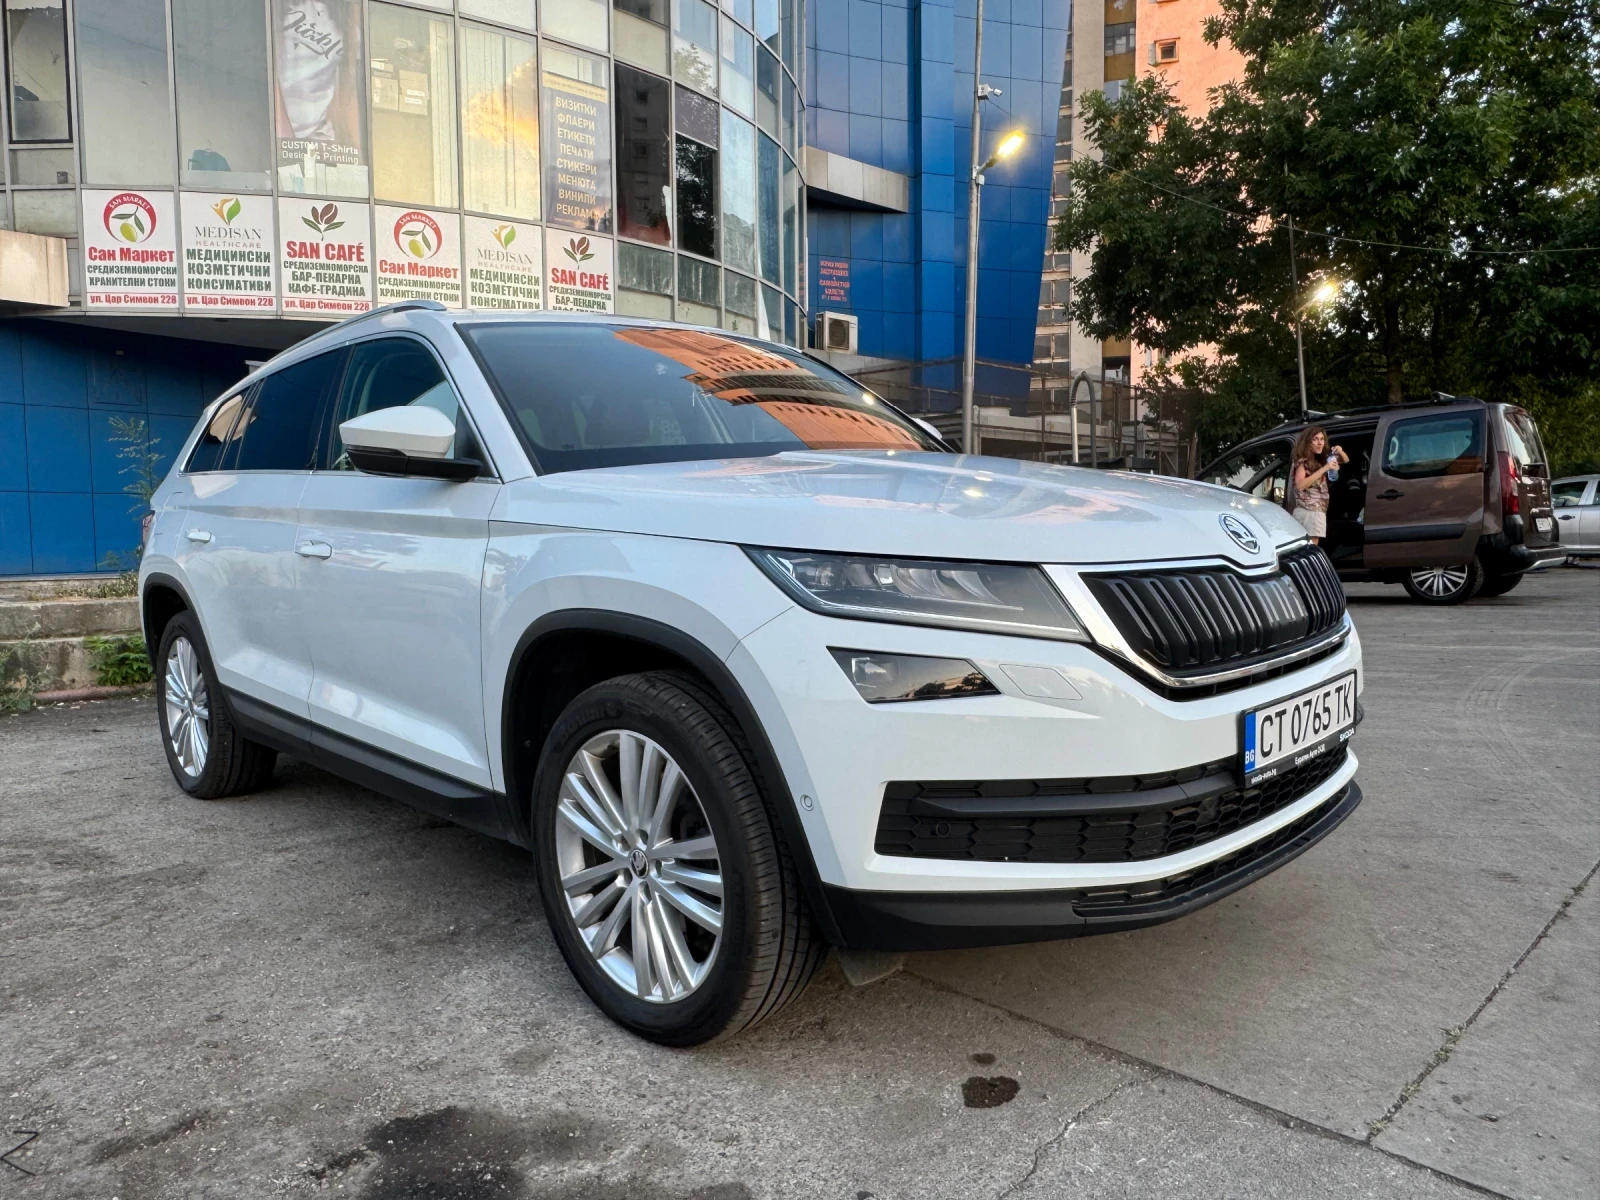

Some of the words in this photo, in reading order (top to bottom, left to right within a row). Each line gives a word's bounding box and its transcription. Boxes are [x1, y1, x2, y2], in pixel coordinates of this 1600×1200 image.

[556, 96, 596, 116] ВИЗИТКИ
[558, 113, 595, 130] ФЛАЕРИ
[558, 128, 596, 146] ЕТИКЕТИ
[321, 143, 358, 154] T-Shirts
[560, 144, 594, 160] ПЕЧАТИ
[282, 150, 306, 160] Desig
[324, 152, 358, 165] Printing
[556, 158, 596, 176] СТИКЕРИ
[558, 174, 596, 190] МЕНЮТА
[109, 198, 122, 208] SAN
[122, 196, 150, 210] MARKET
[558, 189, 596, 205] ВИНИЛИ
[398, 216, 410, 225] SAN
[411, 214, 436, 228] MARKET
[195, 226, 262, 240] MEDISAN
[196, 240, 261, 248] HEALTHCARE
[286, 240, 320, 260] SAN
[324, 242, 364, 262] CAFÉ
[88, 246, 116, 262] Сан
[120, 248, 175, 264] Маркет
[186, 248, 270, 264] МЕДИЦИНСКИ
[477, 248, 533, 265] MEDISAN
[87, 264, 177, 275] СРЕДИЗЕМНОМОРСКИ
[188, 263, 270, 277] КОЗМЕТИЧНИ
[284, 260, 368, 274] СРЕДИЗЕМНОМОРСКА
[379, 260, 406, 274] Сан
[408, 261, 458, 279] Маркет
[478, 262, 532, 273] HEALTHCARE
[89, 276, 146, 287] ХРАНИТЕЛНИ
[148, 277, 176, 288] СТОКИ
[188, 278, 272, 292] КОНСУМАТИВИ
[292, 270, 361, 285] БАР-ПЕКАРНА
[378, 276, 460, 291] СРЕДИЗЕМНОМОРСКИ
[470, 268, 540, 287] МЕДИЦИНСКИ
[551, 267, 576, 286] SAN
[580, 272, 609, 290] CAFÉ
[288, 283, 366, 298] КАФЕ-ГРАДИНА
[380, 288, 432, 300] ХРАНИТЕЛНИ
[434, 292, 460, 302] СТОКИ
[470, 281, 540, 300] КОЗМЕТИЧНИ
[90, 295, 103, 304] ул.
[105, 294, 122, 304] Цар
[124, 294, 159, 304] Симеон
[160, 295, 176, 304] 228
[186, 296, 200, 305] ул.
[202, 296, 218, 306] Цар
[220, 296, 256, 306] Симеон
[257, 296, 274, 306] 228
[284, 300, 298, 308] ул.
[299, 300, 316, 310] Цар
[318, 301, 352, 311] Симеон
[354, 302, 370, 311] 228
[555, 294, 607, 310] БАР-ПЕКАРНА
[1260, 708, 1286, 758] CT
[1291, 690, 1331, 745] 0765
[1335, 680, 1352, 724] TK
[1245, 749, 1254, 764] BG
